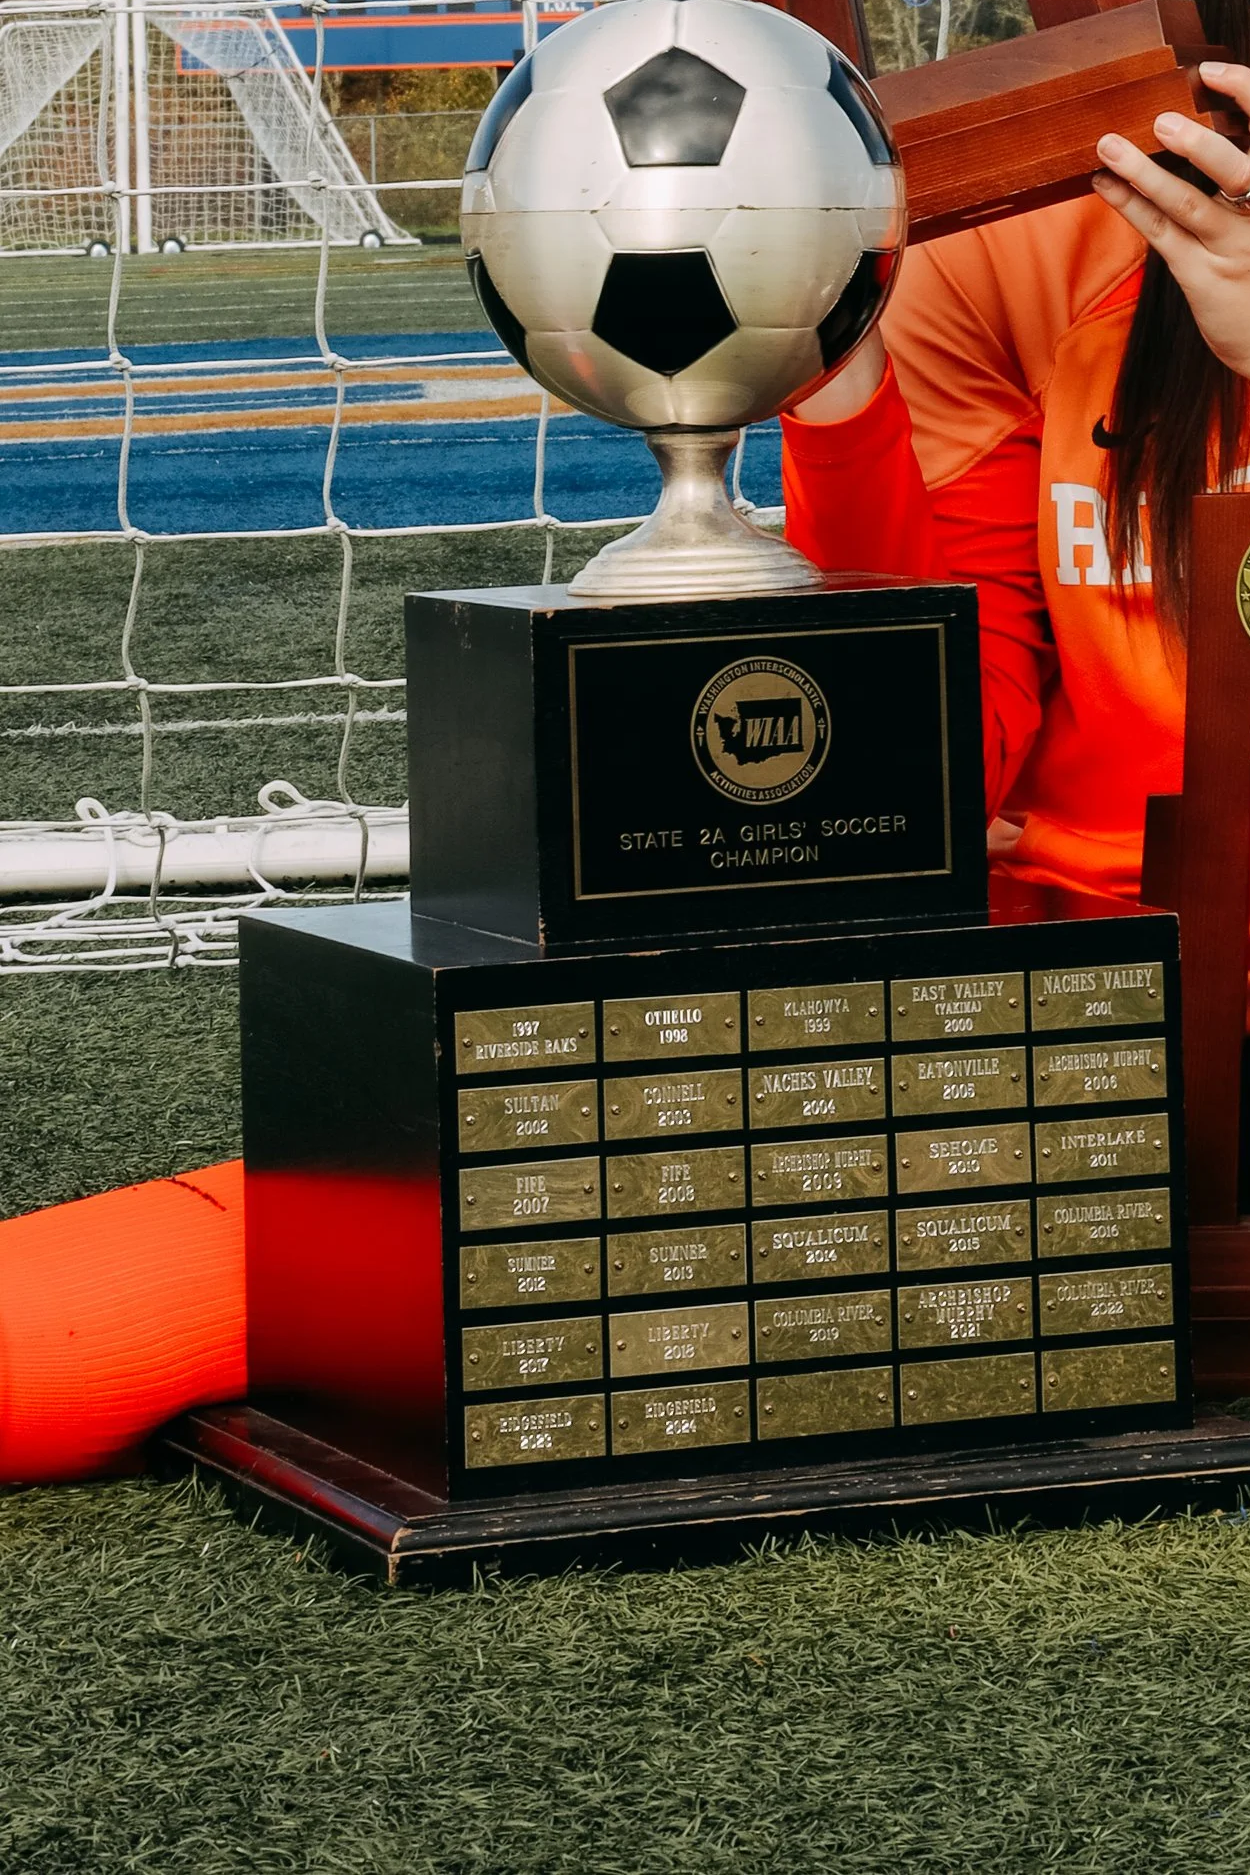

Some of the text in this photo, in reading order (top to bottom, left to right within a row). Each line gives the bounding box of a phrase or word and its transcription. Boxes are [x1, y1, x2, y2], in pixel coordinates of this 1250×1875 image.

[699, 661, 823, 715] WASHINGTON INTERSCHOLASTIC
[744, 715, 800, 749] WIAA
[710, 763, 816, 801] ACTIVITIES ASSOCIATION
[619, 815, 907, 851] STATE 2A GIRLS' SOCCER
[711, 845, 819, 870] CHAMPION
[912, 981, 1005, 1002] EAST VALLEY
[1043, 969, 1153, 995] NACHES VALLEY
[645, 1008, 703, 1025] OTHELLO
[784, 998, 850, 1017] KLAHOWYA
[935, 1000, 982, 1017] (YAKIMA)
[1085, 1001, 1113, 1016] 2001
[512, 1020, 540, 1037] 1997
[804, 1019, 831, 1034] 1999
[943, 1017, 974, 1033] 2000
[659, 1029, 689, 1045] 1998
[475, 1037, 578, 1060] RIVERSIDE RAMS
[917, 1058, 1000, 1080] EATONVILLE
[1048, 1049, 1152, 1072] ARCHBISHOP MURPHY
[763, 1067, 873, 1094] NACHES VALLEY
[1084, 1076, 1118, 1091] 2006
[643, 1083, 706, 1105] CONNELL
[943, 1084, 976, 1101] 2005
[504, 1094, 559, 1115] SULTAN
[803, 1100, 836, 1116] 2004
[657, 1110, 692, 1127] 2003
[516, 1120, 549, 1137] 2002
[929, 1138, 998, 1159] SEHOME
[1061, 1129, 1146, 1150] INTERLAKE
[771, 1149, 872, 1173] ARCHBISHOP MURPHY
[948, 1159, 981, 1175] 2010
[1089, 1153, 1118, 1168] 2011
[661, 1164, 691, 1182] FIFE
[802, 1173, 842, 1191] 2009
[516, 1175, 546, 1194] FIFE
[658, 1186, 695, 1204] 2008
[513, 1197, 550, 1216] 2007
[1054, 1202, 1153, 1224] COLUMBIA RIVER
[916, 1214, 1011, 1239] SQUALICUM
[1089, 1224, 1120, 1239] 2016
[772, 1226, 868, 1249] SQUALICUM
[949, 1237, 981, 1253] 2015
[649, 1244, 708, 1263] SUMNER
[806, 1250, 838, 1265] 2014
[507, 1256, 557, 1273] SUMNER
[663, 1265, 695, 1282] 2013
[517, 1277, 546, 1293] 2012
[1056, 1278, 1156, 1303] COLUMBIA RIVER
[918, 1286, 1011, 1309] ARCHBISHOP
[773, 1304, 875, 1328] COLUMBIA RIVER
[935, 1305, 995, 1325] MURPHY
[1090, 1302, 1124, 1317] 2022
[648, 1323, 710, 1343] LIBERTY
[809, 1328, 839, 1343] 2019
[950, 1324, 981, 1339] 2021
[502, 1336, 565, 1357] LIBERTY
[664, 1344, 696, 1360] 2018
[519, 1358, 549, 1375] 2017
[644, 1398, 716, 1419] RIDGEFIELD
[499, 1412, 572, 1433] RIDGEFIELD
[665, 1419, 697, 1435] 2024
[520, 1434, 552, 1450] 2023
